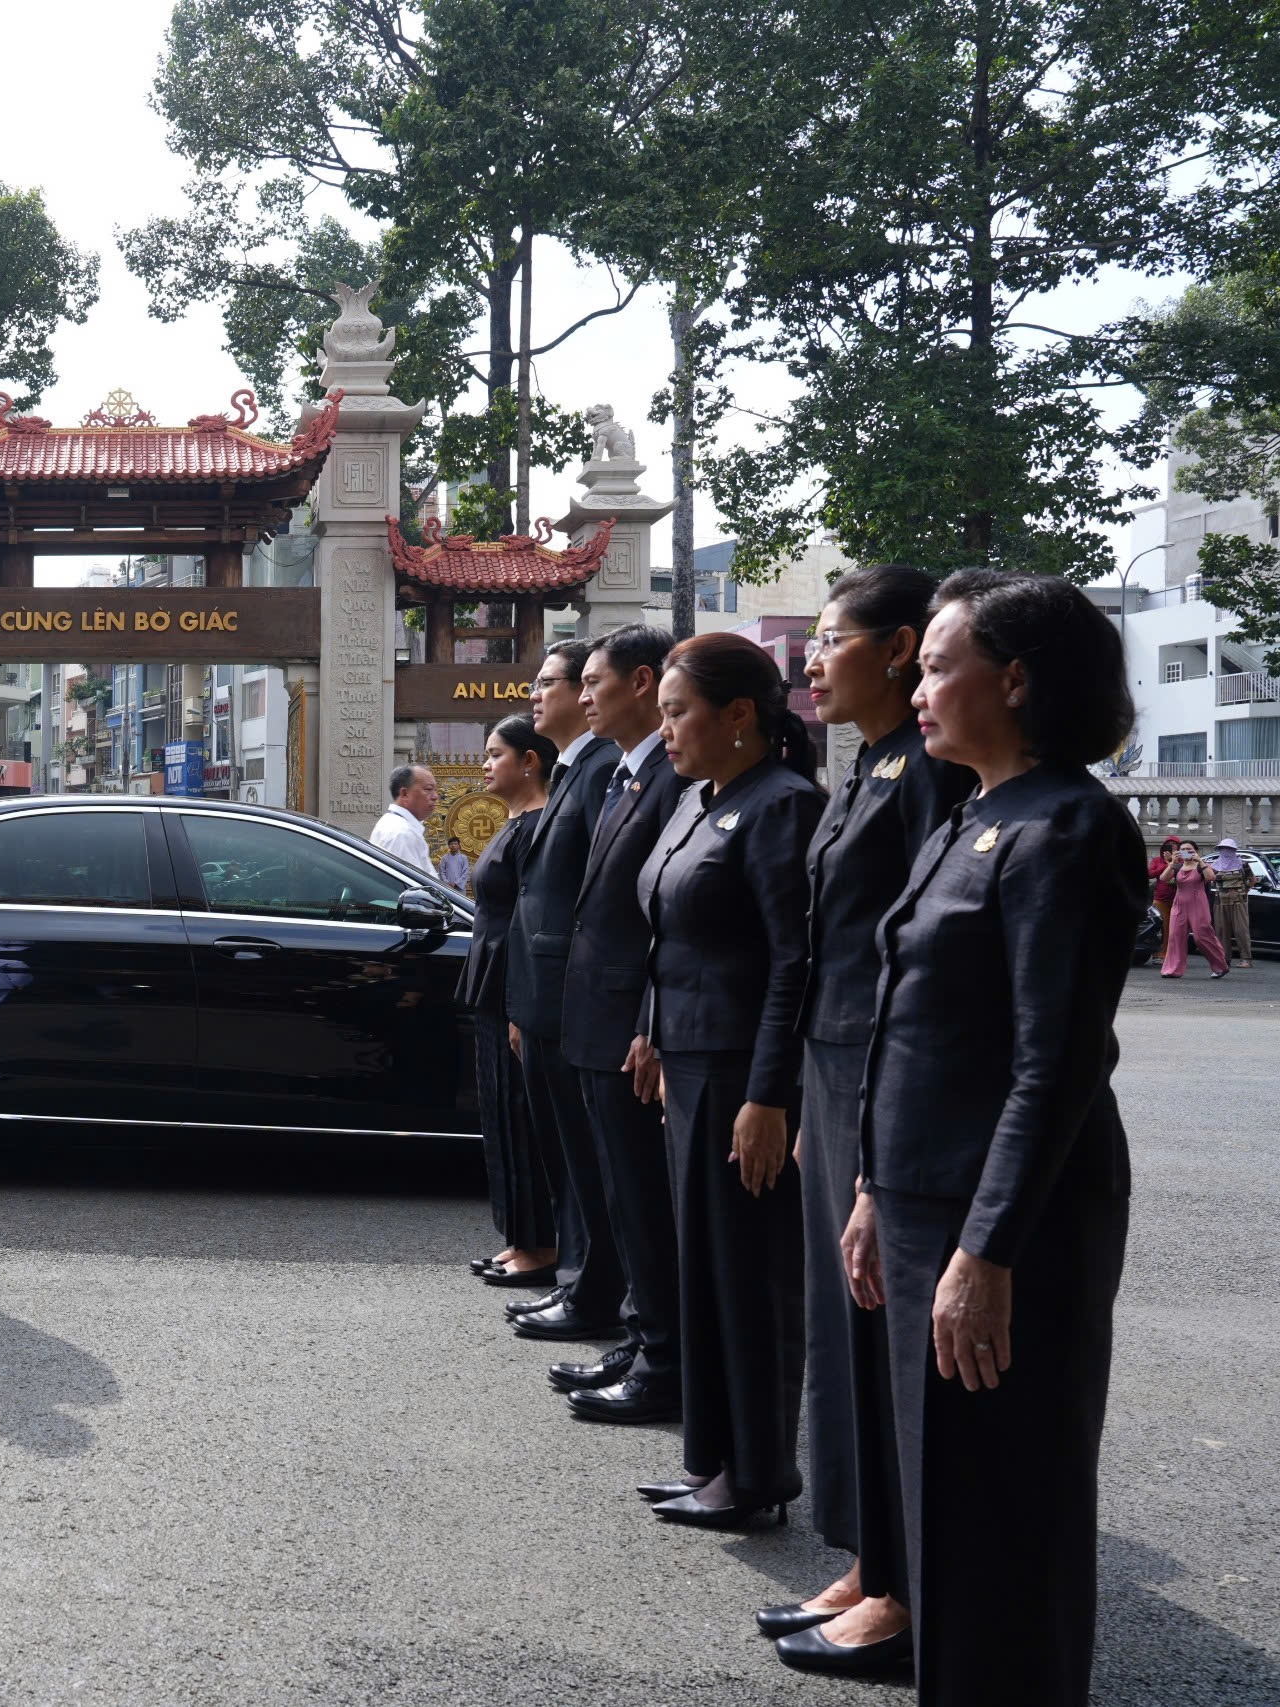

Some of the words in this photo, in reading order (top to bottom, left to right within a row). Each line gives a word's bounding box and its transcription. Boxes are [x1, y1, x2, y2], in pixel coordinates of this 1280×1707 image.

[0, 606, 73, 631] CÙNG
[81, 606, 125, 631] LÊN
[134, 606, 170, 631] BỜ
[179, 606, 238, 631] GIÁC
[453, 682, 486, 699] AN
[493, 682, 530, 702] LẠC
[345, 725, 368, 738] Soi
[338, 743, 375, 757] Chân
